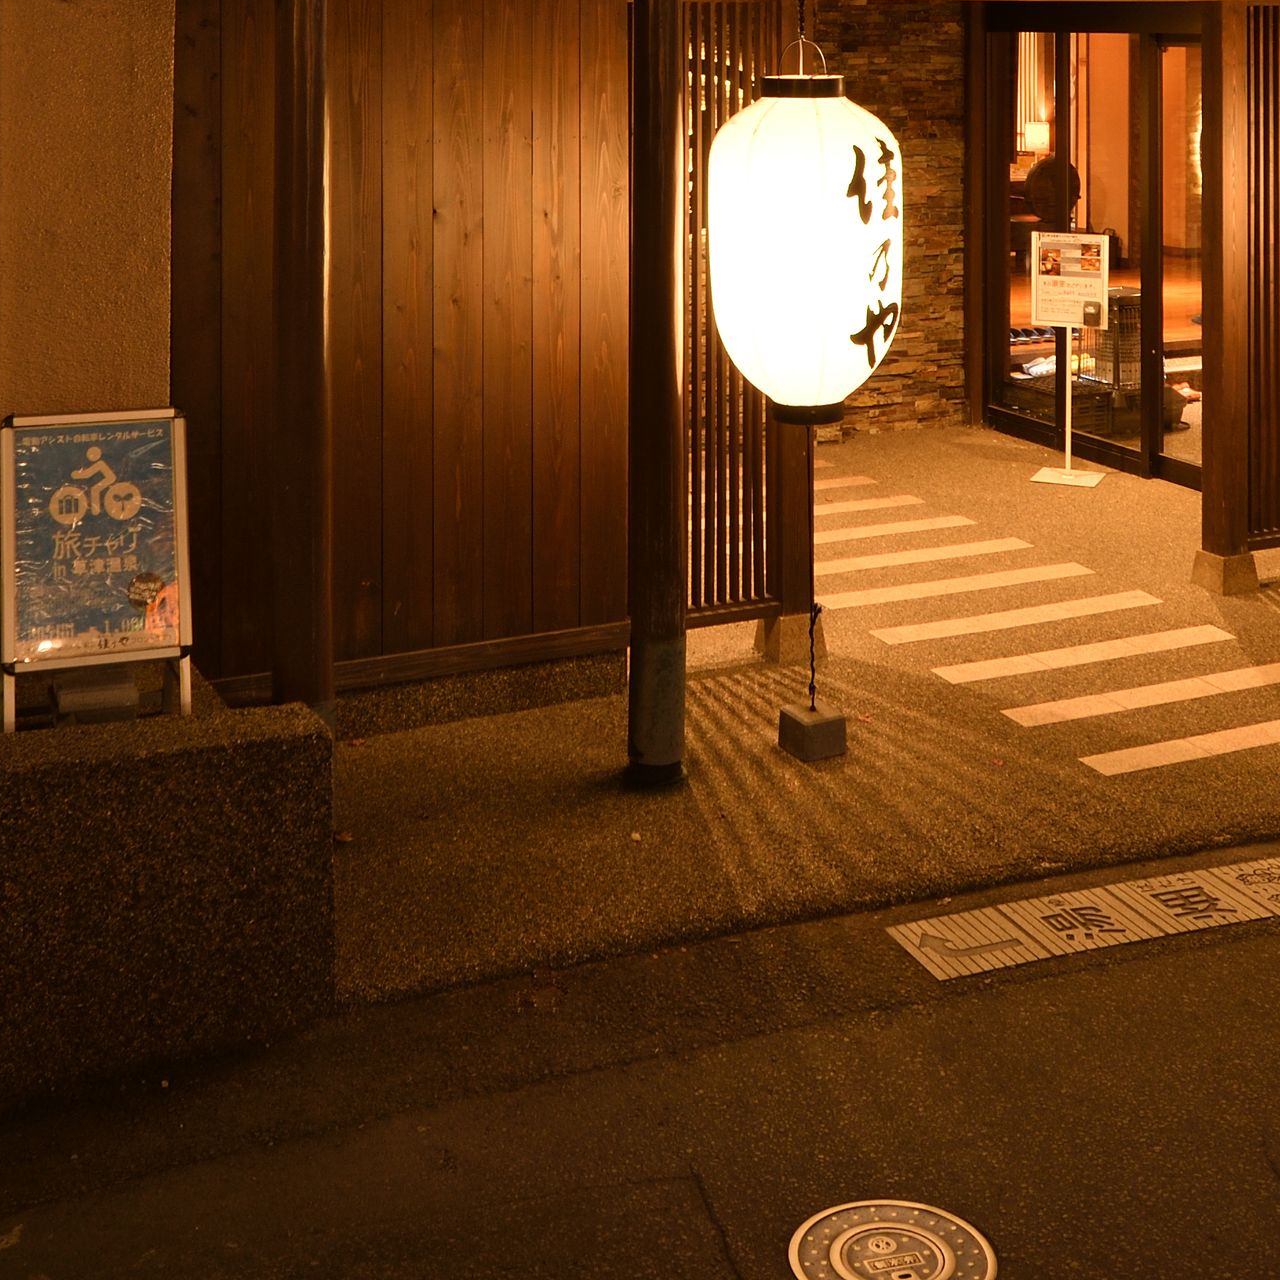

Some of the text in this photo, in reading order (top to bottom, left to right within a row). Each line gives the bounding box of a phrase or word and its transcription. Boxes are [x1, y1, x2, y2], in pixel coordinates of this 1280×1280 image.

[846, 136, 902, 368] 佳乃や
[1039, 885, 1240, 942] 湯畑
